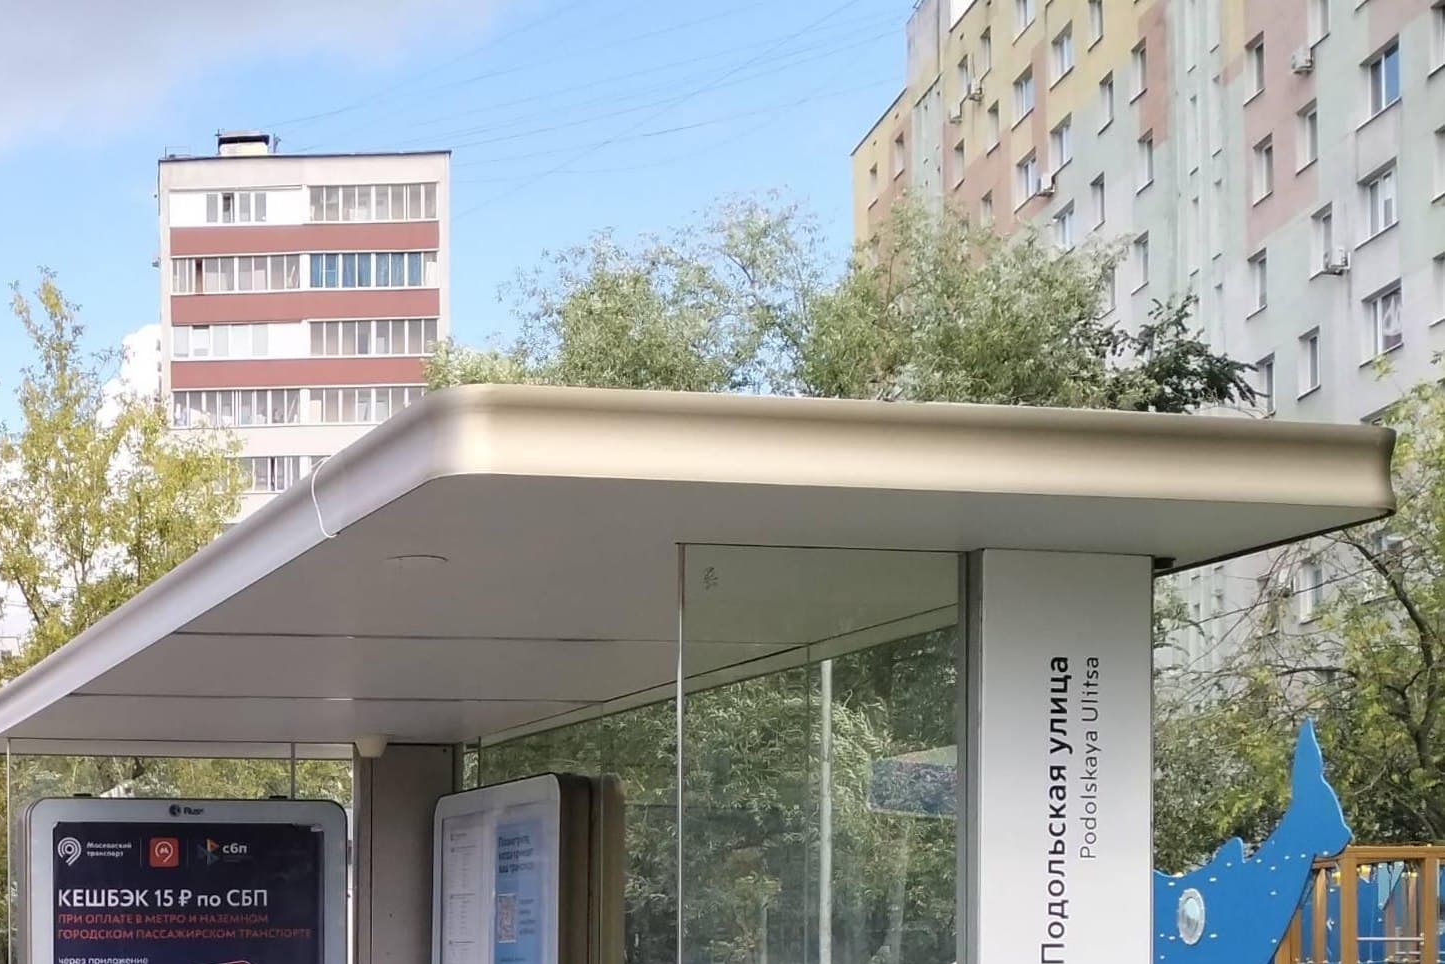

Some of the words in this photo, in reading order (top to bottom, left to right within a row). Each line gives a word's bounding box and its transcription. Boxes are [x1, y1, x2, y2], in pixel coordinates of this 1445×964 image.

[1049, 655, 1073, 754] улица
[1080, 656, 1099, 722] Ulitsa
[1080, 730, 1102, 859] Podolskaya
[222, 843, 247, 854] сбп
[1041, 764, 1068, 964] Подольская
[58, 889, 149, 907] КЕШБЭК
[155, 890, 173, 906] 15
[197, 893, 221, 906] по
[227, 890, 268, 906] СБП
[58, 915, 82, 924] ПРИ
[85, 914, 133, 924] ОПЛАТЕ
[136, 914, 142, 923] В
[145, 914, 185, 923] МЕТРО
[188, 914, 196, 923] И
[199, 914, 268, 923] НАЗЕМНОМ
[58, 929, 133, 940] ГОРОДСКОМ
[136, 929, 235, 939] ПАССАЖИРСКОМ
[239, 928, 312, 938] ТРАНСПОРТЕ
